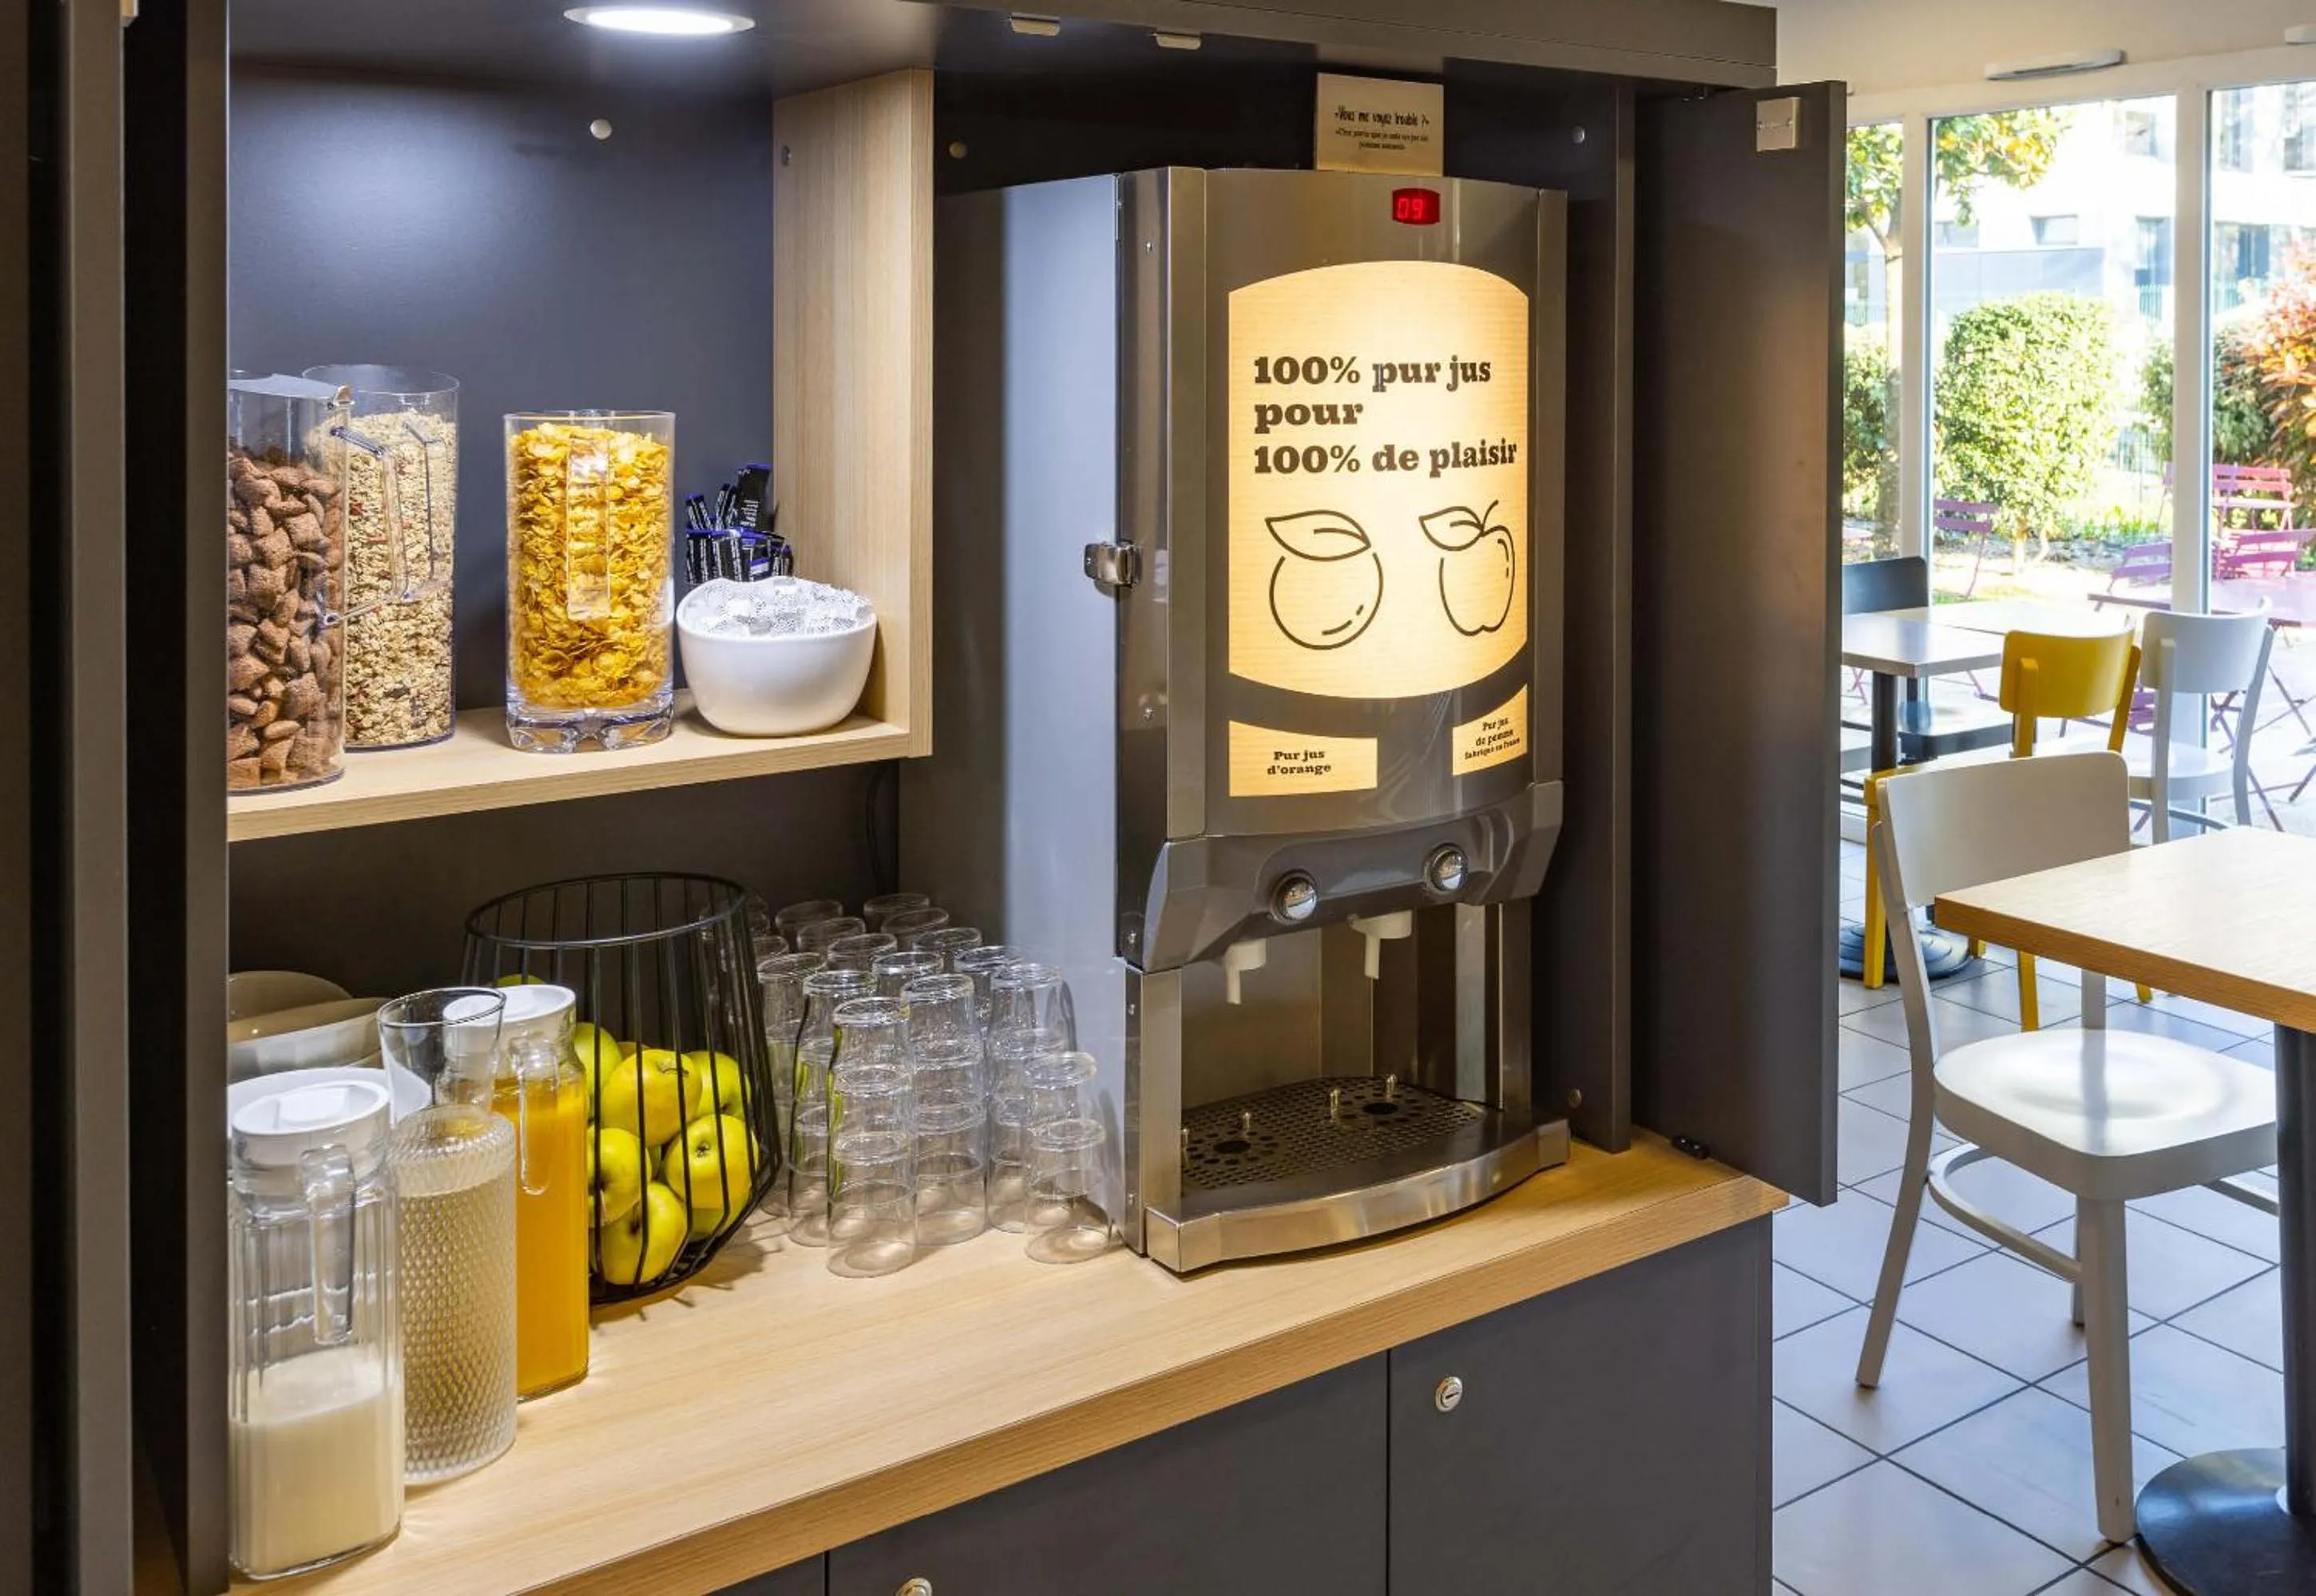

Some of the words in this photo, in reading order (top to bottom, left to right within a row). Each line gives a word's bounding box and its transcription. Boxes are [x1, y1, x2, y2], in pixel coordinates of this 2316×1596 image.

[1254, 355, 1361, 385] 100%
[1372, 361, 1442, 393] pur
[1446, 354, 1492, 392] jus
[1254, 403, 1364, 434] pour
[1254, 445, 1361, 474] 100%
[1372, 444, 1419, 472] de
[1429, 438, 1517, 479] plaisir
[1482, 722, 1497, 731] Pur
[1475, 736, 1486, 746] de
[1274, 750, 1300, 761] Pur
[1302, 750, 1325, 762] jus
[1267, 764, 1332, 776] d'orange
